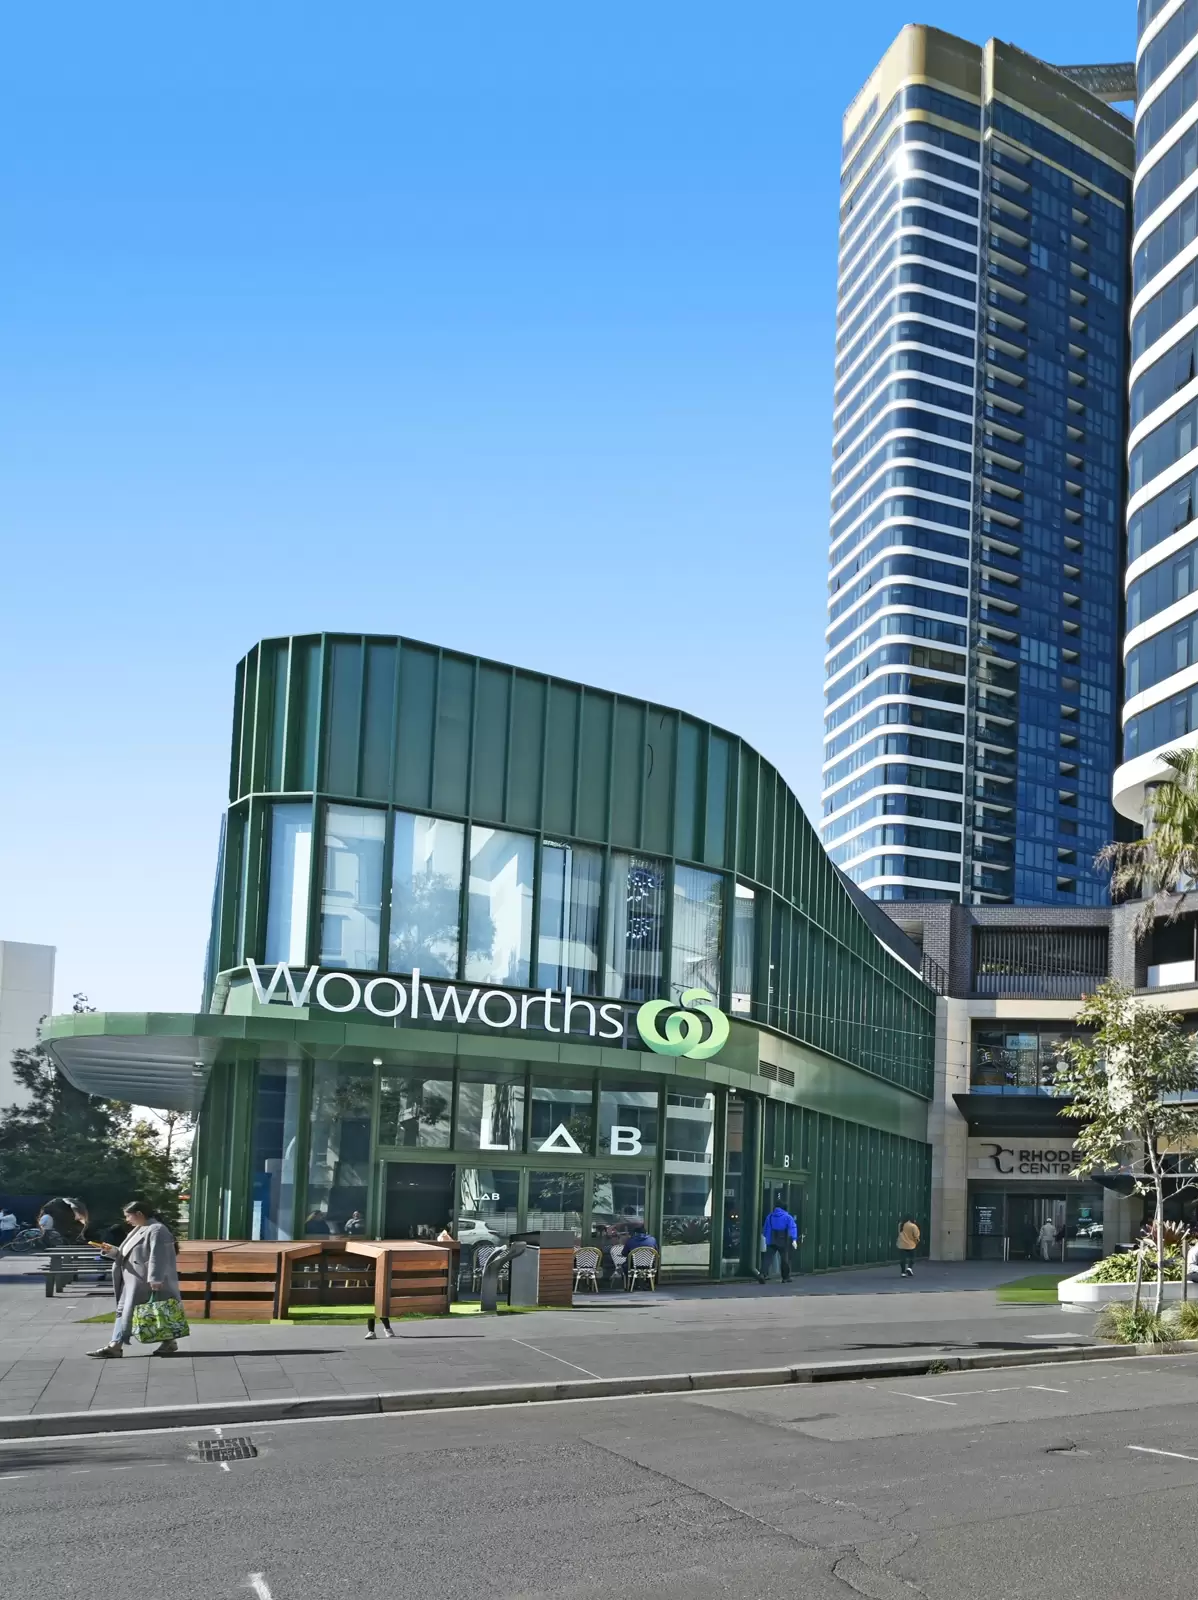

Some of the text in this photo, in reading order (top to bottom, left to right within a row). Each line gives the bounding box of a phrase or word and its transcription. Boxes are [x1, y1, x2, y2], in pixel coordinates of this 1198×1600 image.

[246, 958, 623, 1039] Woolworths
[784, 1154, 791, 1168] B
[473, 1192, 500, 1201] LAB
